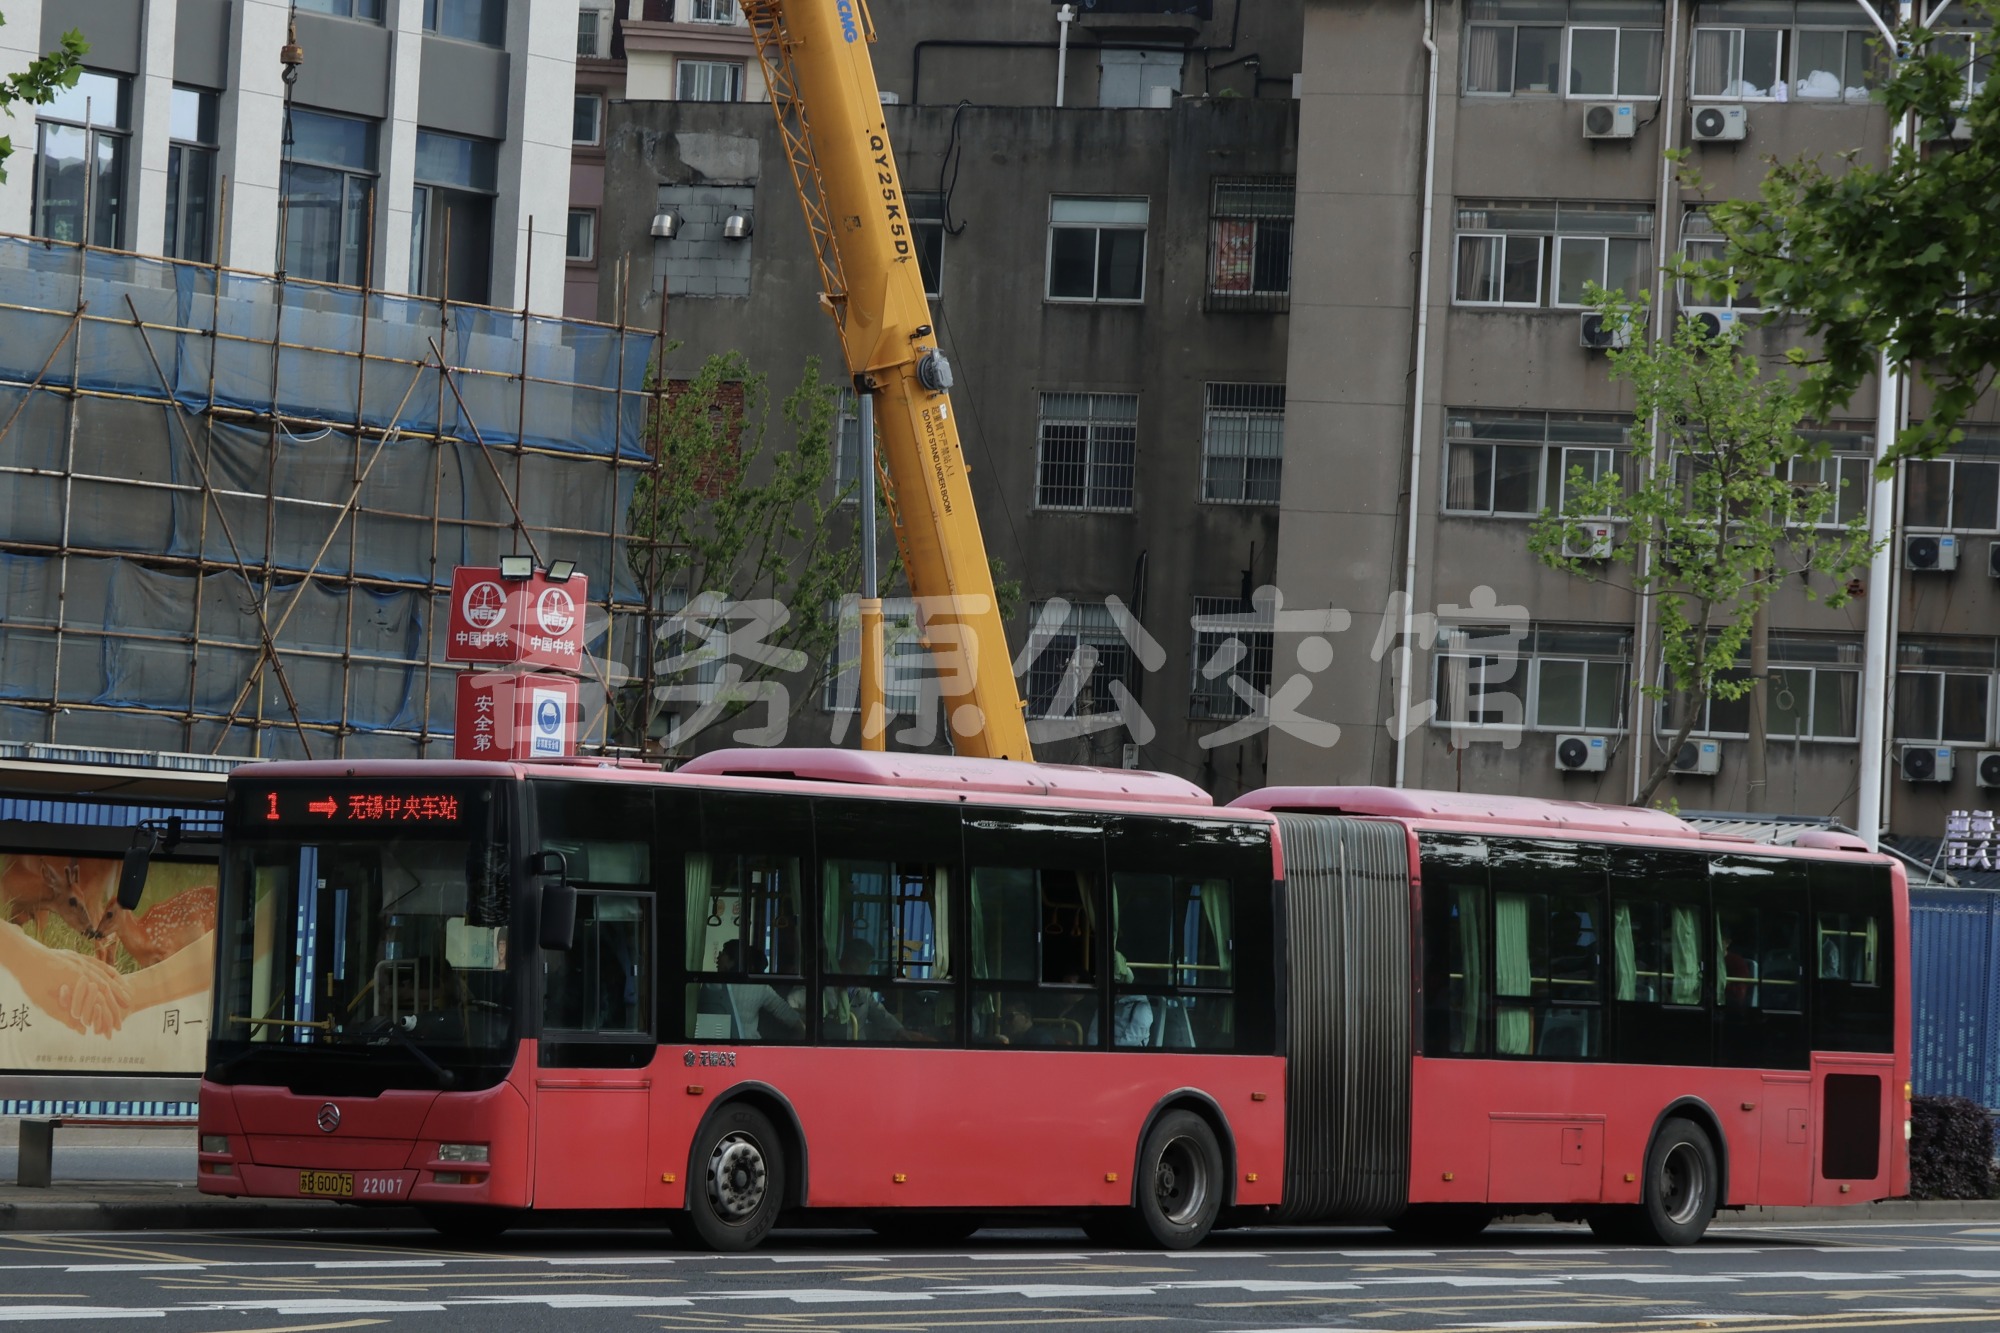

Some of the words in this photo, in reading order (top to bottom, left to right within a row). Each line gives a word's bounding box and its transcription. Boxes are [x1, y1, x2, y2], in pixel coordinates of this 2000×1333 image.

[836, 0, 858, 43] CMG
[870, 135, 909, 255] QY25K5D
[922, 409, 931, 422] DO
[925, 421, 935, 438] NOT
[928, 438, 940, 463] STAND
[934, 463, 946, 490] UNDER
[456, 631, 509, 648] 中国中铁
[530, 635, 575, 656] 中国中铁
[267, 792, 279, 820] 1
[347, 795, 458, 820] 无锡中央车站
[363, 1177, 403, 1194] 22007
